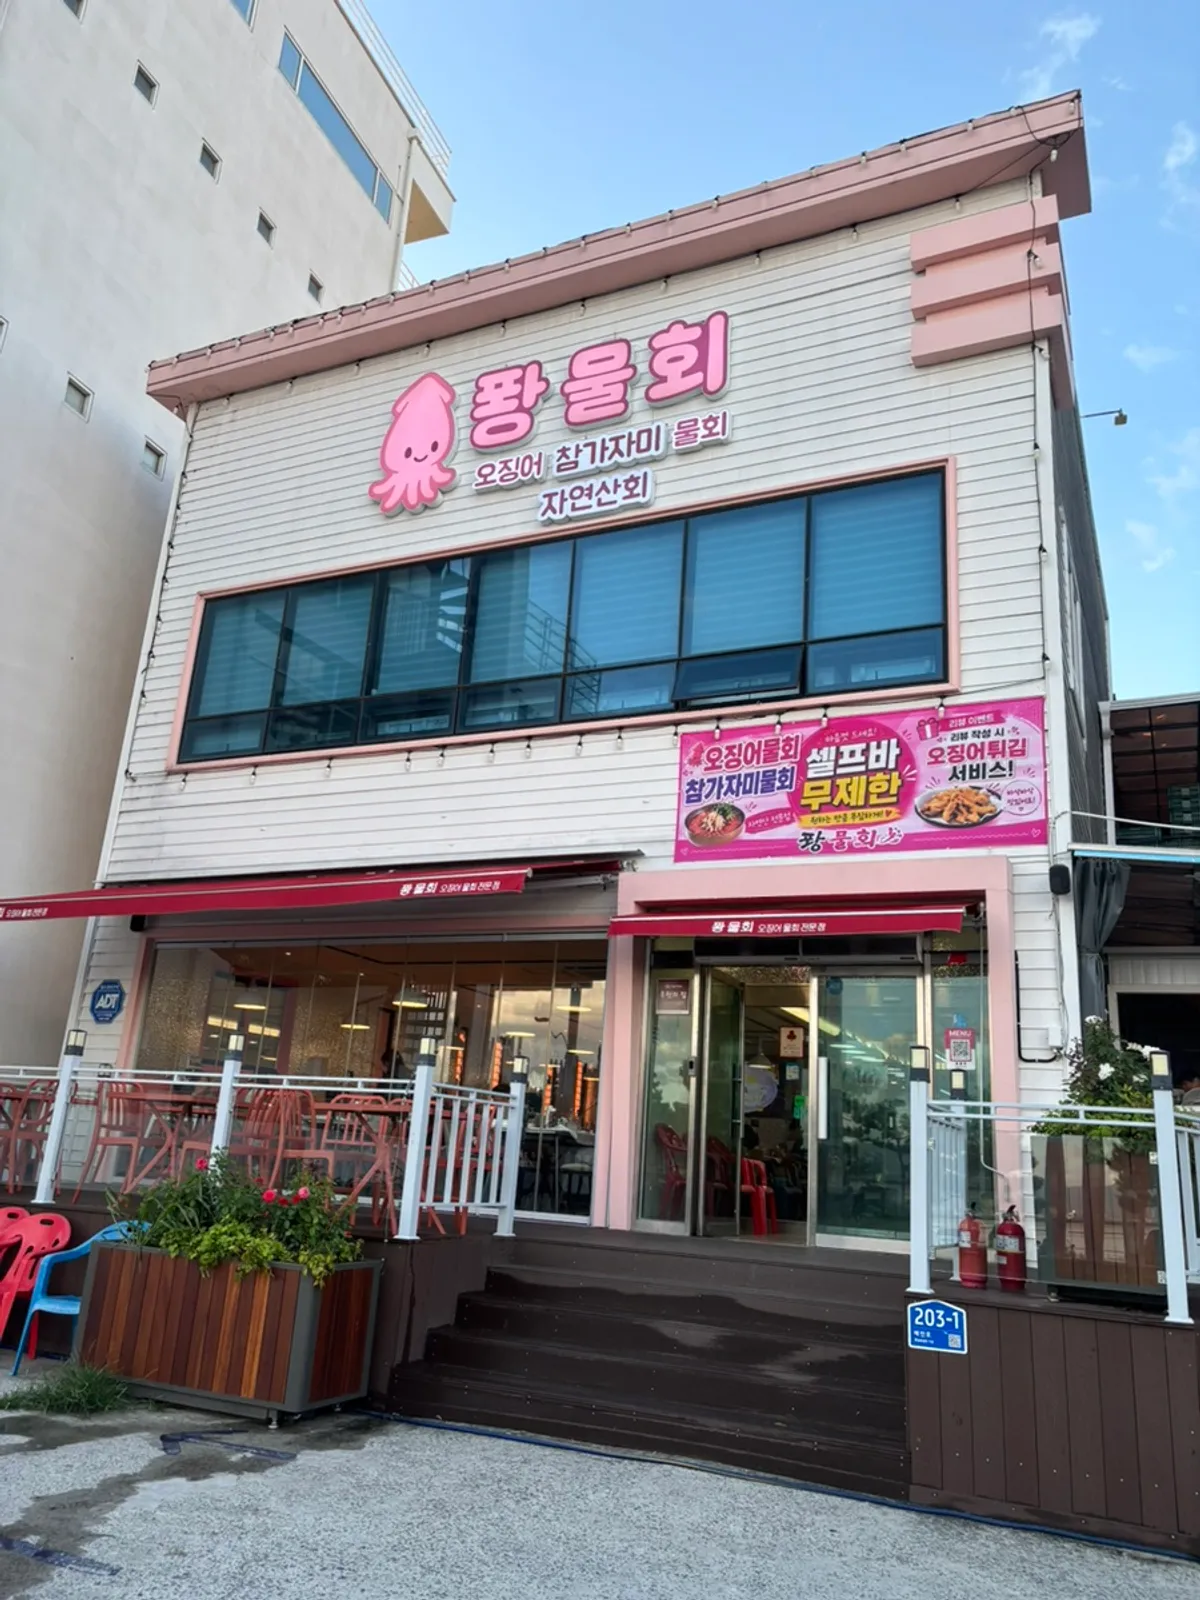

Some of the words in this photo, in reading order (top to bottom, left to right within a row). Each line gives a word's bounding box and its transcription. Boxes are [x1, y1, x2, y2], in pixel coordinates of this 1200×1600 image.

[473, 451, 543, 488] 오징어
[555, 425, 662, 473] 참가자미
[672, 412, 728, 446] 물회
[540, 471, 649, 518] 자연산회
[949, 718, 966, 728] 리뷰
[968, 713, 994, 725] 이벤트
[950, 732, 968, 742] 리뷰
[971, 728, 992, 739] 작성
[994, 727, 1005, 737] 시
[703, 734, 800, 772] 오징어물회
[806, 738, 900, 779] 셀프바
[927, 737, 1027, 765] 오징어튀김
[685, 765, 795, 804] 참가자미물회
[948, 760, 1014, 781] 서비스!
[800, 771, 902, 812] 무제한
[94, 993, 120, 1009] ADT
[914, 1307, 959, 1329] 203-1
